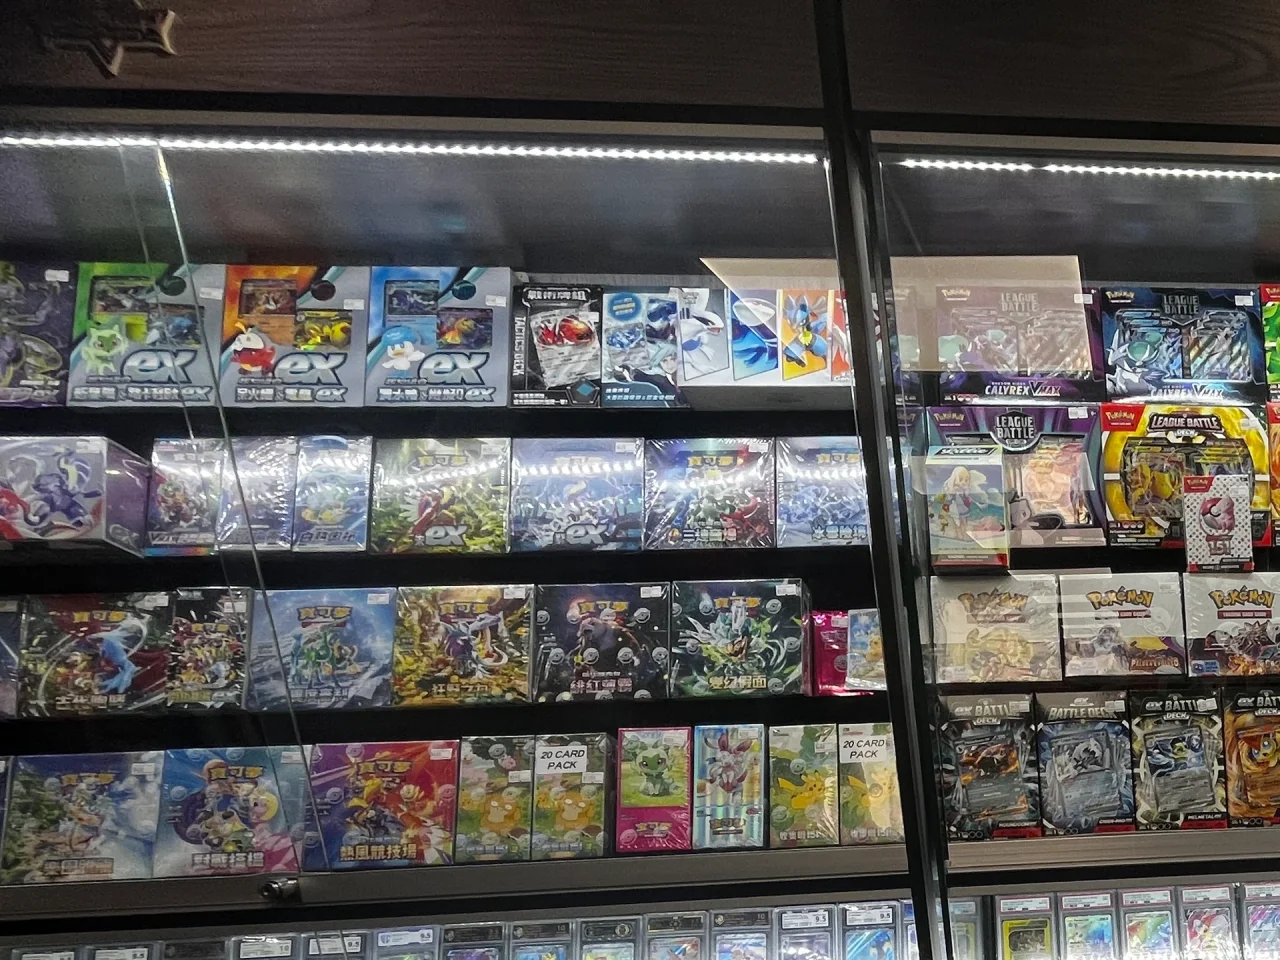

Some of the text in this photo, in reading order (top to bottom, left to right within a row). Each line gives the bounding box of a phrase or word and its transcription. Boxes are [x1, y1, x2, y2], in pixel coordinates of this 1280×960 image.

[1000, 292, 1038, 303] LEAGUE
[1163, 294, 1199, 305] LEAGUE
[1000, 302, 1038, 312] BATTLE
[1163, 305, 1199, 315] BATTLE
[513, 316, 526, 376] TACTICS DECK
[122, 349, 197, 384] ex
[274, 352, 347, 385] ex
[419, 352, 490, 385] ex
[984, 384, 1030, 396] CALYREX
[996, 416, 1034, 428] LEAGUE
[1152, 416, 1220, 430] LEAGUE BATTLE
[996, 428, 1035, 440] BATTLE
[1208, 540, 1232, 556] 151
[1049, 707, 1083, 720] BATTLE
[1257, 708, 1279, 716] DECK
[843, 738, 885, 749] 20 CARD
[540, 749, 585, 759] 20 CARD
[849, 749, 878, 759] PACK
[547, 760, 577, 770] PACK
